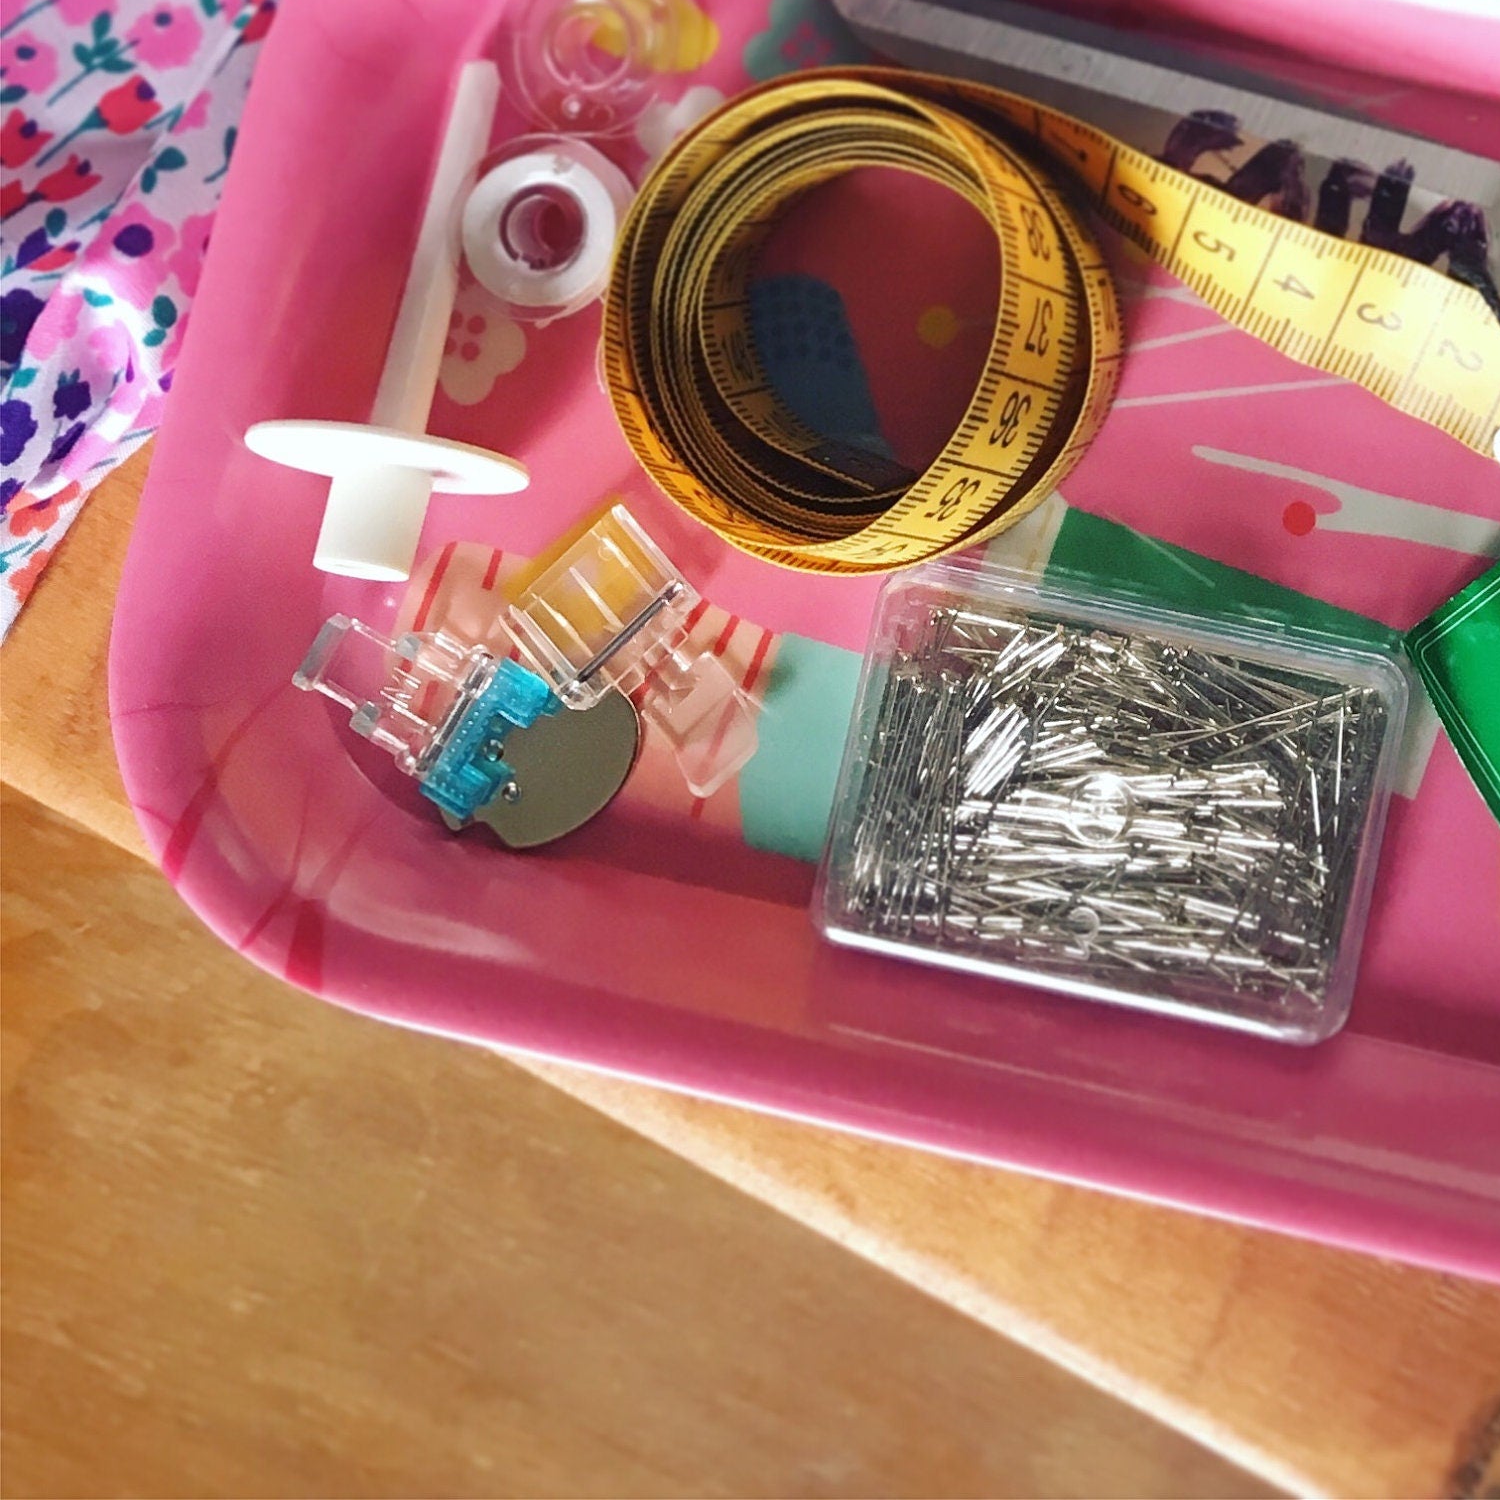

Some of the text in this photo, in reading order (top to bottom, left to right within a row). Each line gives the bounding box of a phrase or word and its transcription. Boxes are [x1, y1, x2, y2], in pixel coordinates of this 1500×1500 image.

[1118, 184, 1157, 216] 6
[1020, 204, 1050, 261] 38
[1193, 231, 1236, 262] 5
[1273, 274, 1315, 300] 4
[1025, 297, 1053, 357] 37
[1357, 303, 1401, 331] 3
[1438, 339, 1483, 372] 2
[989, 391, 1031, 448] 36
[924, 477, 981, 521] 35
